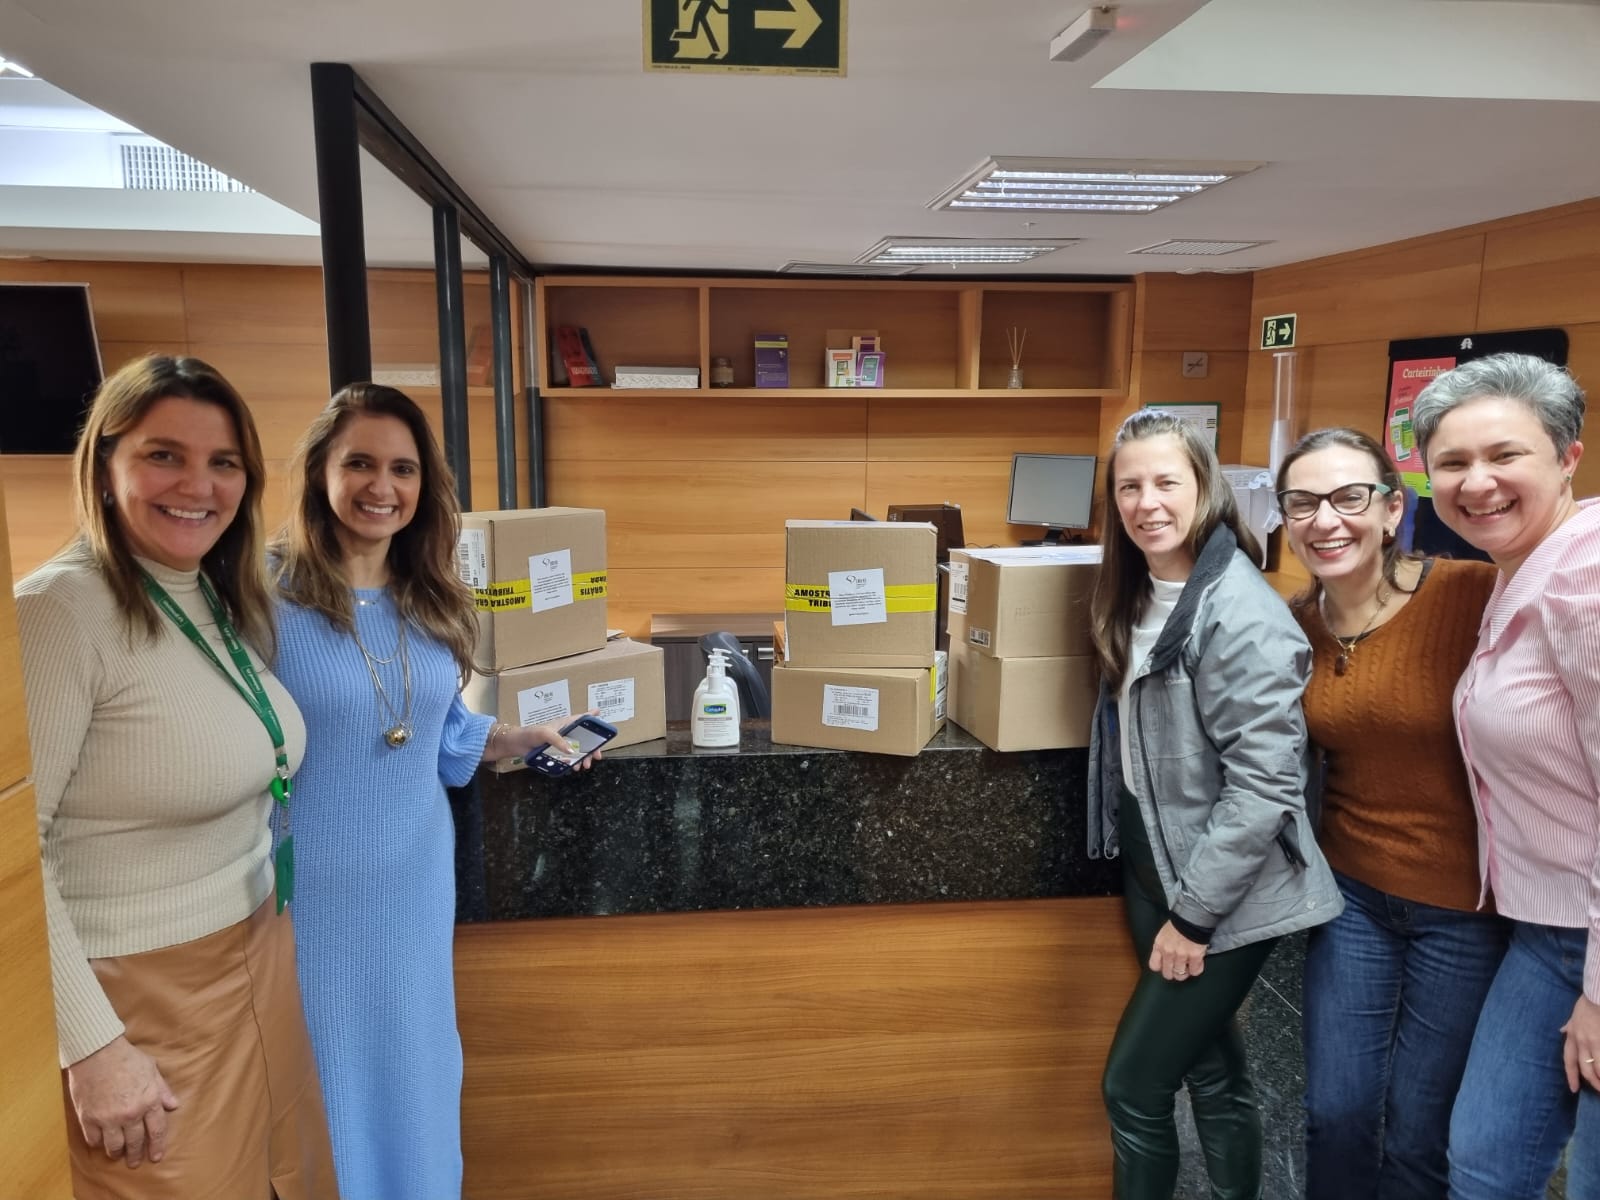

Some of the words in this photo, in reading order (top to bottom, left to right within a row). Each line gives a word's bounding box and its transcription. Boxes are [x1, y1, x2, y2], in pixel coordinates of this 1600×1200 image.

[580, 585, 604, 596] GRÁTIS
[794, 588, 831, 598] AMOSTR
[490, 596, 526, 607] AMOSTRA
[808, 599, 832, 608] TRIB
